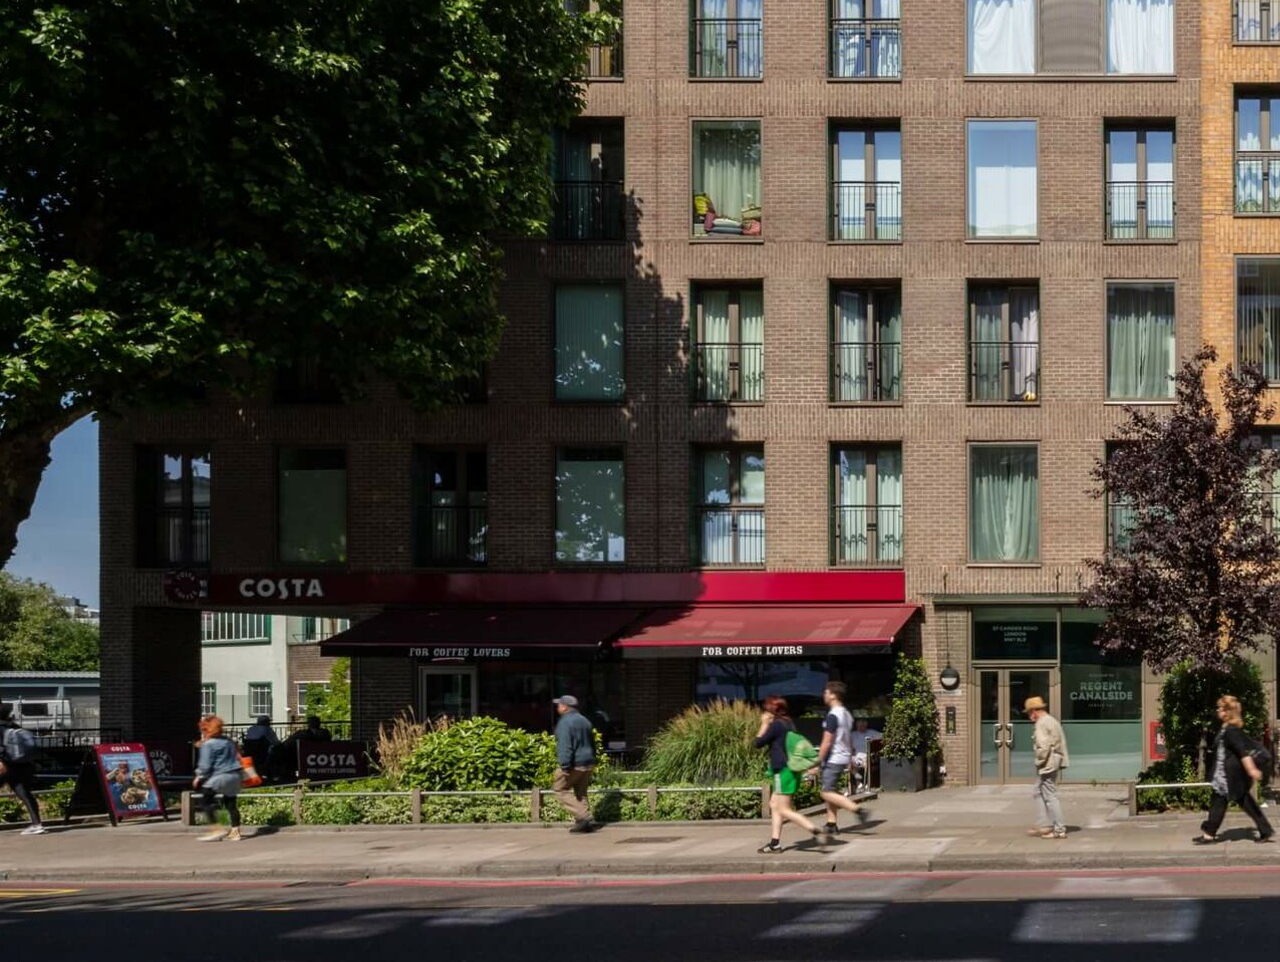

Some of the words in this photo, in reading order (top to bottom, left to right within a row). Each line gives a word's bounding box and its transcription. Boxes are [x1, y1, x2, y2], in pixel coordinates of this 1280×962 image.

[239, 579, 324, 599] COSTA
[410, 648, 429, 657] FOR
[433, 648, 470, 657] COFFEE
[474, 648, 511, 657] LOVERS
[702, 646, 723, 656] FOR
[727, 646, 762, 656] COFFEE
[766, 645, 803, 655] LOVERS
[1080, 681, 1123, 691] REGENT
[1070, 691, 1133, 701] CANALSIDE
[306, 754, 356, 767] COSTA
